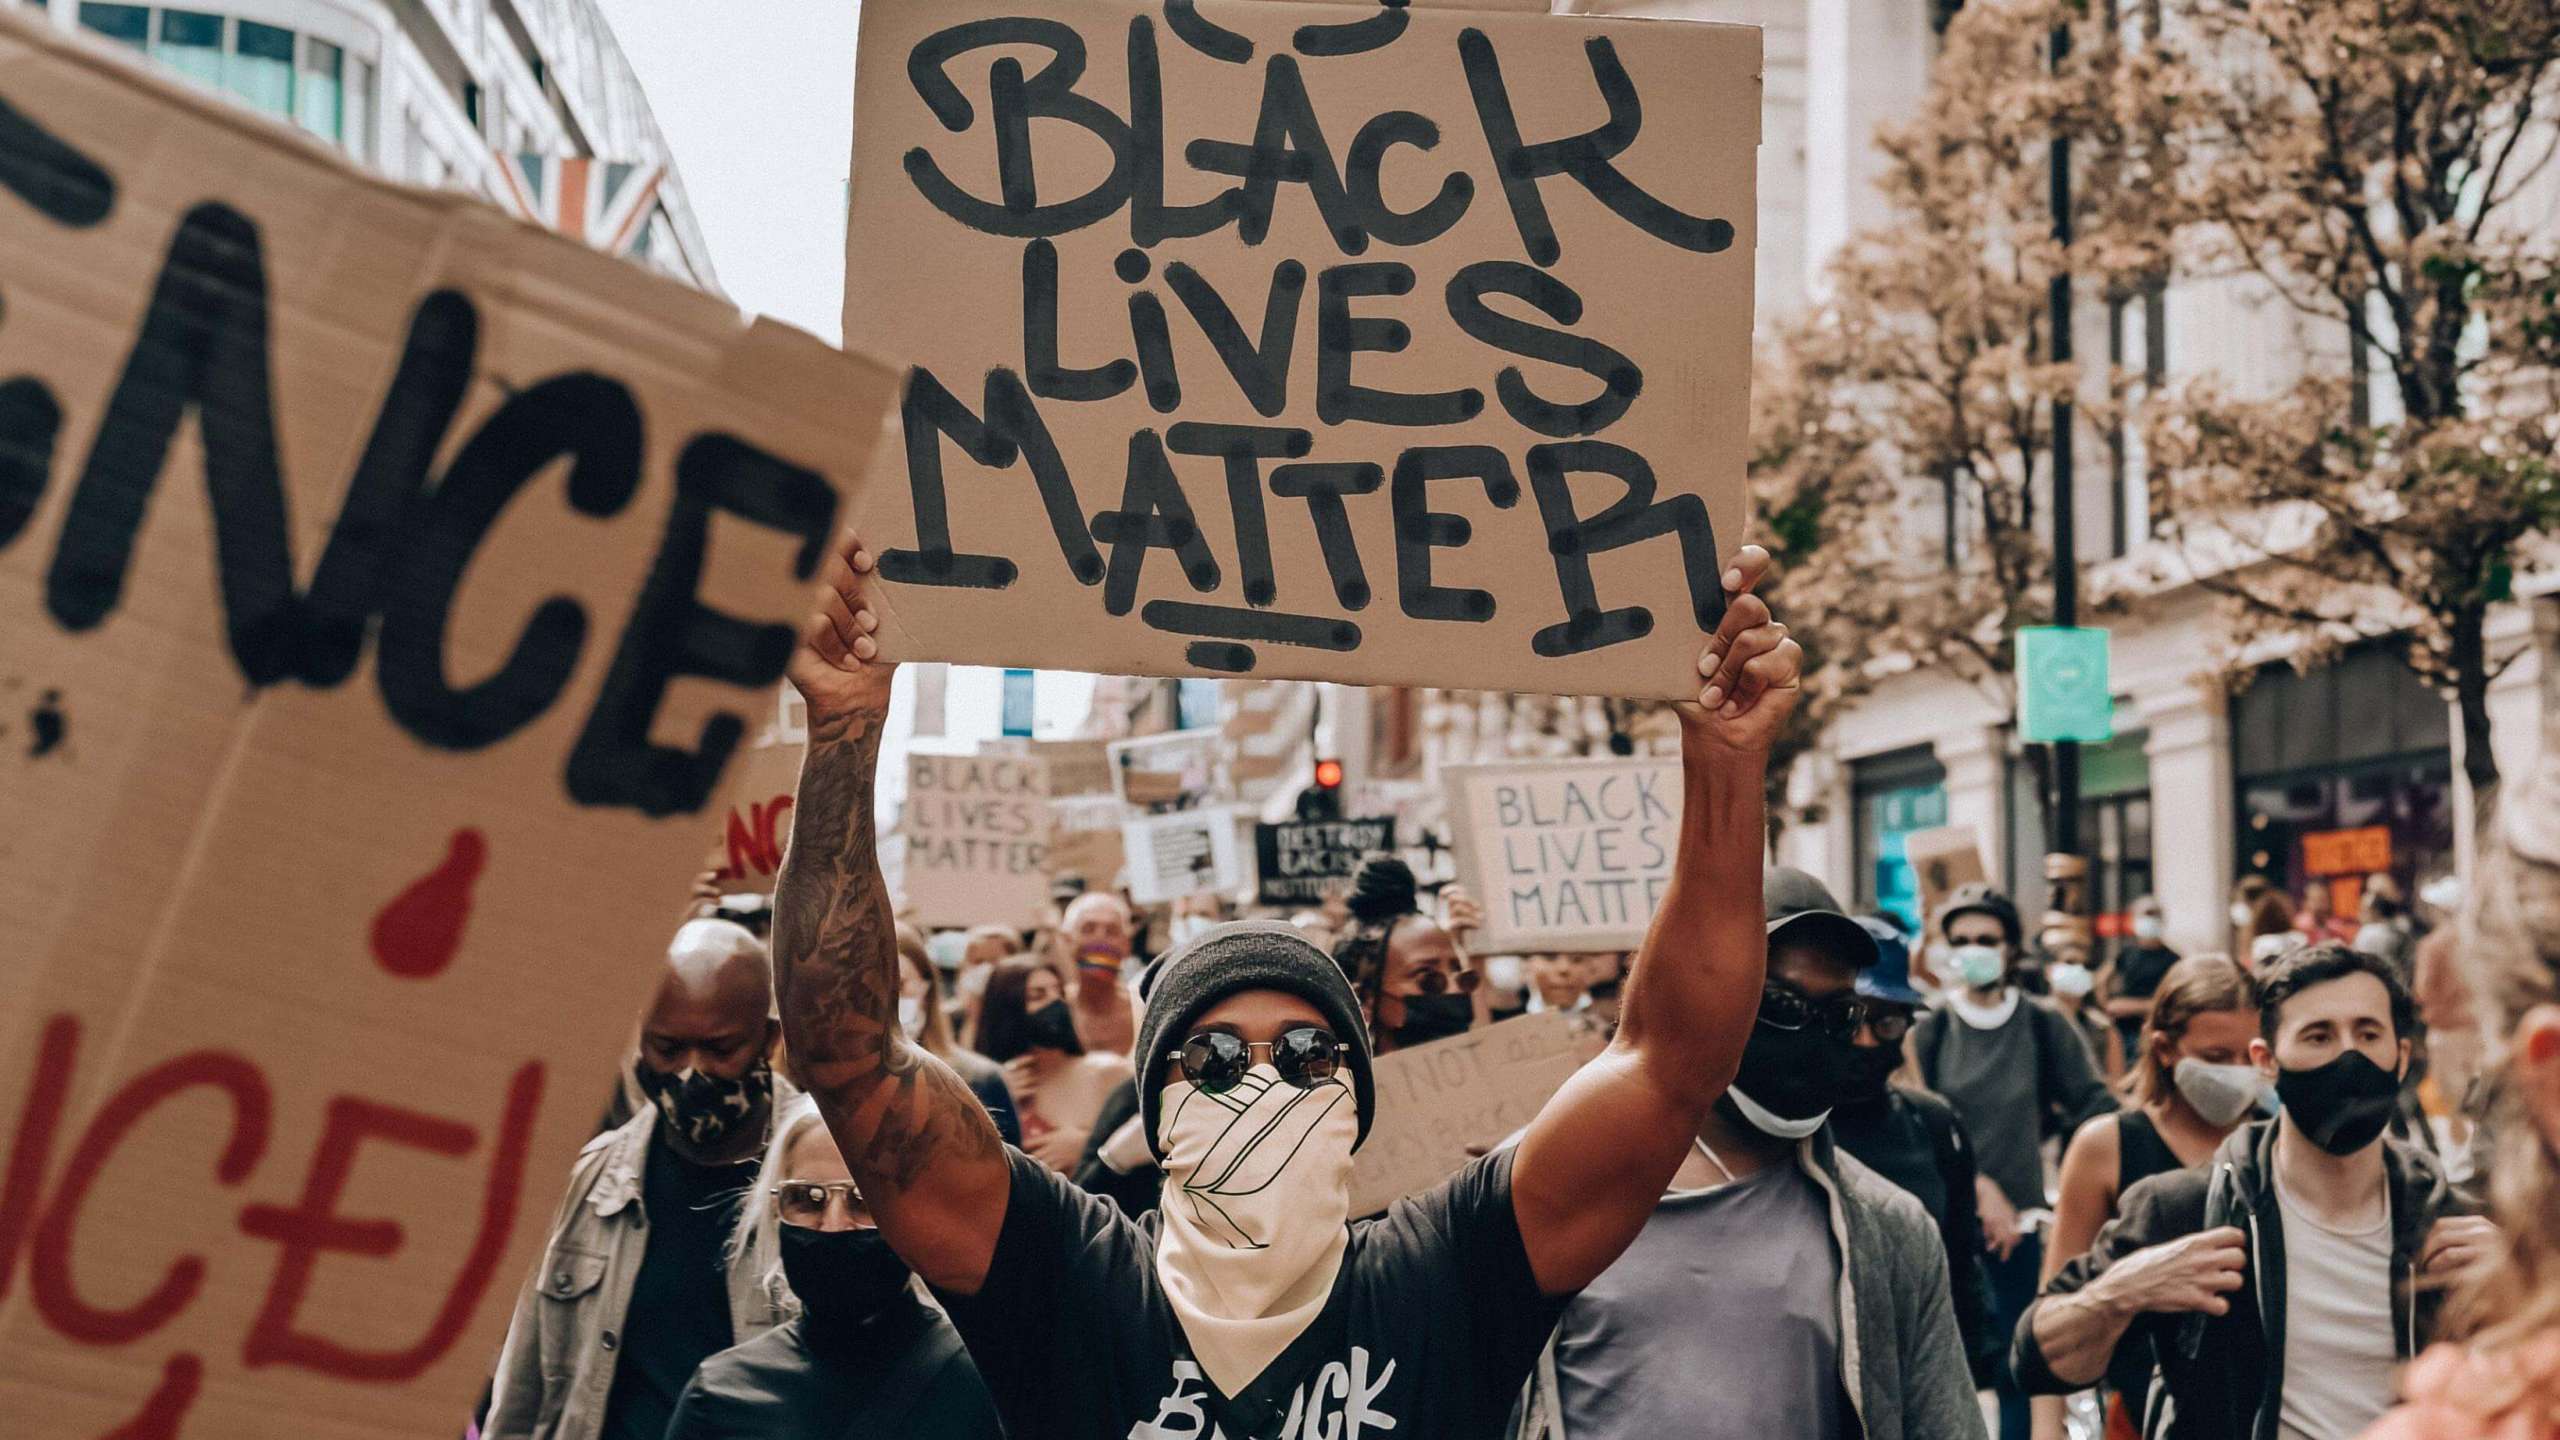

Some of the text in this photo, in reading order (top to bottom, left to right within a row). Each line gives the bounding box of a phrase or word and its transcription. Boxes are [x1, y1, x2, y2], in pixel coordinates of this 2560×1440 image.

[904, 15, 1734, 267] BLACK
[877, 364, 1730, 657] MATTER
[914, 761, 1040, 795] BLACK
[1496, 771, 1672, 828] BLACK
[914, 800, 1032, 836] LIVES
[908, 836, 1053, 875] MATTER
[1503, 825, 1667, 875] LIVES
[1397, 1040, 1484, 1103] NOT
